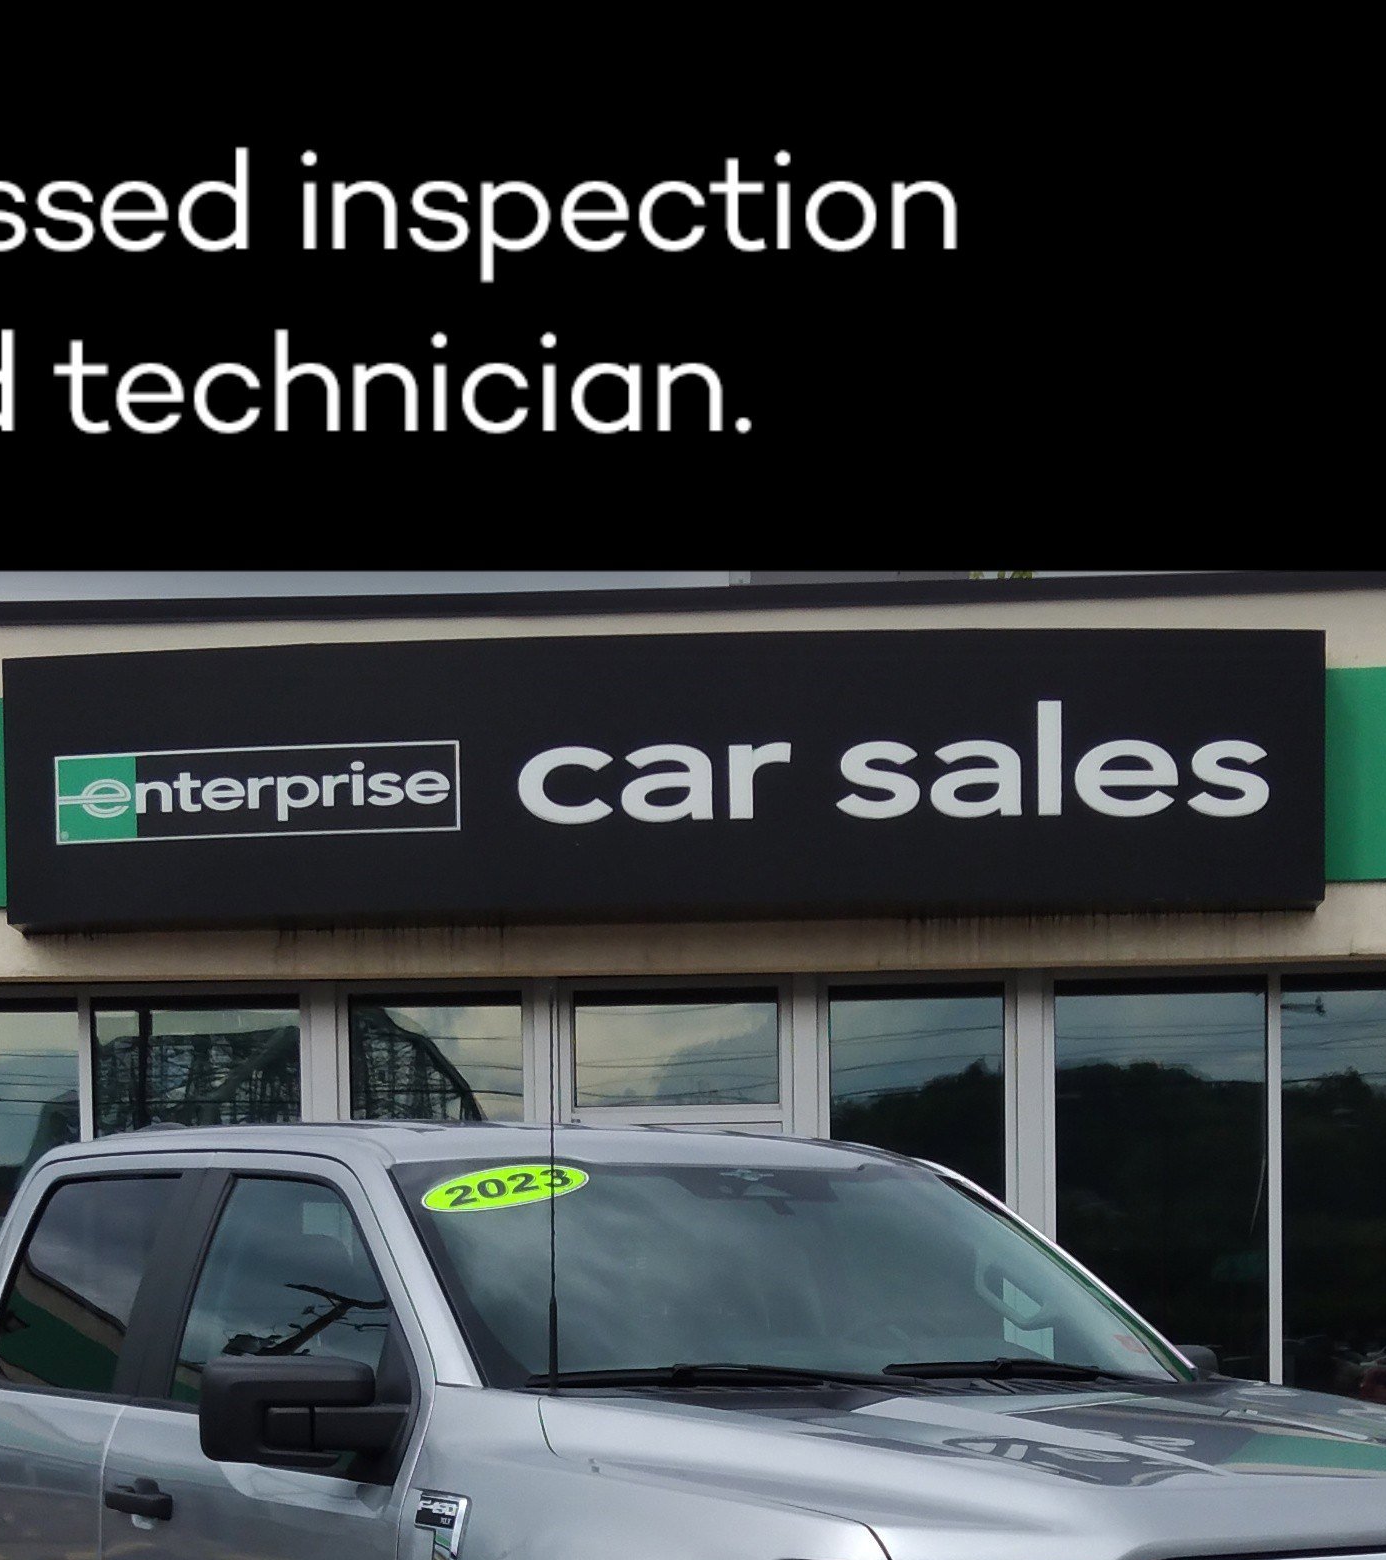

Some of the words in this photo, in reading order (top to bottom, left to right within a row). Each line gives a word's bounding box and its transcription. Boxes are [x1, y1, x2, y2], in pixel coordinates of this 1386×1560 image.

[81, 761, 450, 821] enterprise
[518, 742, 791, 824] car
[836, 700, 1270, 819] sales
[445, 1168, 572, 1207] 2023
